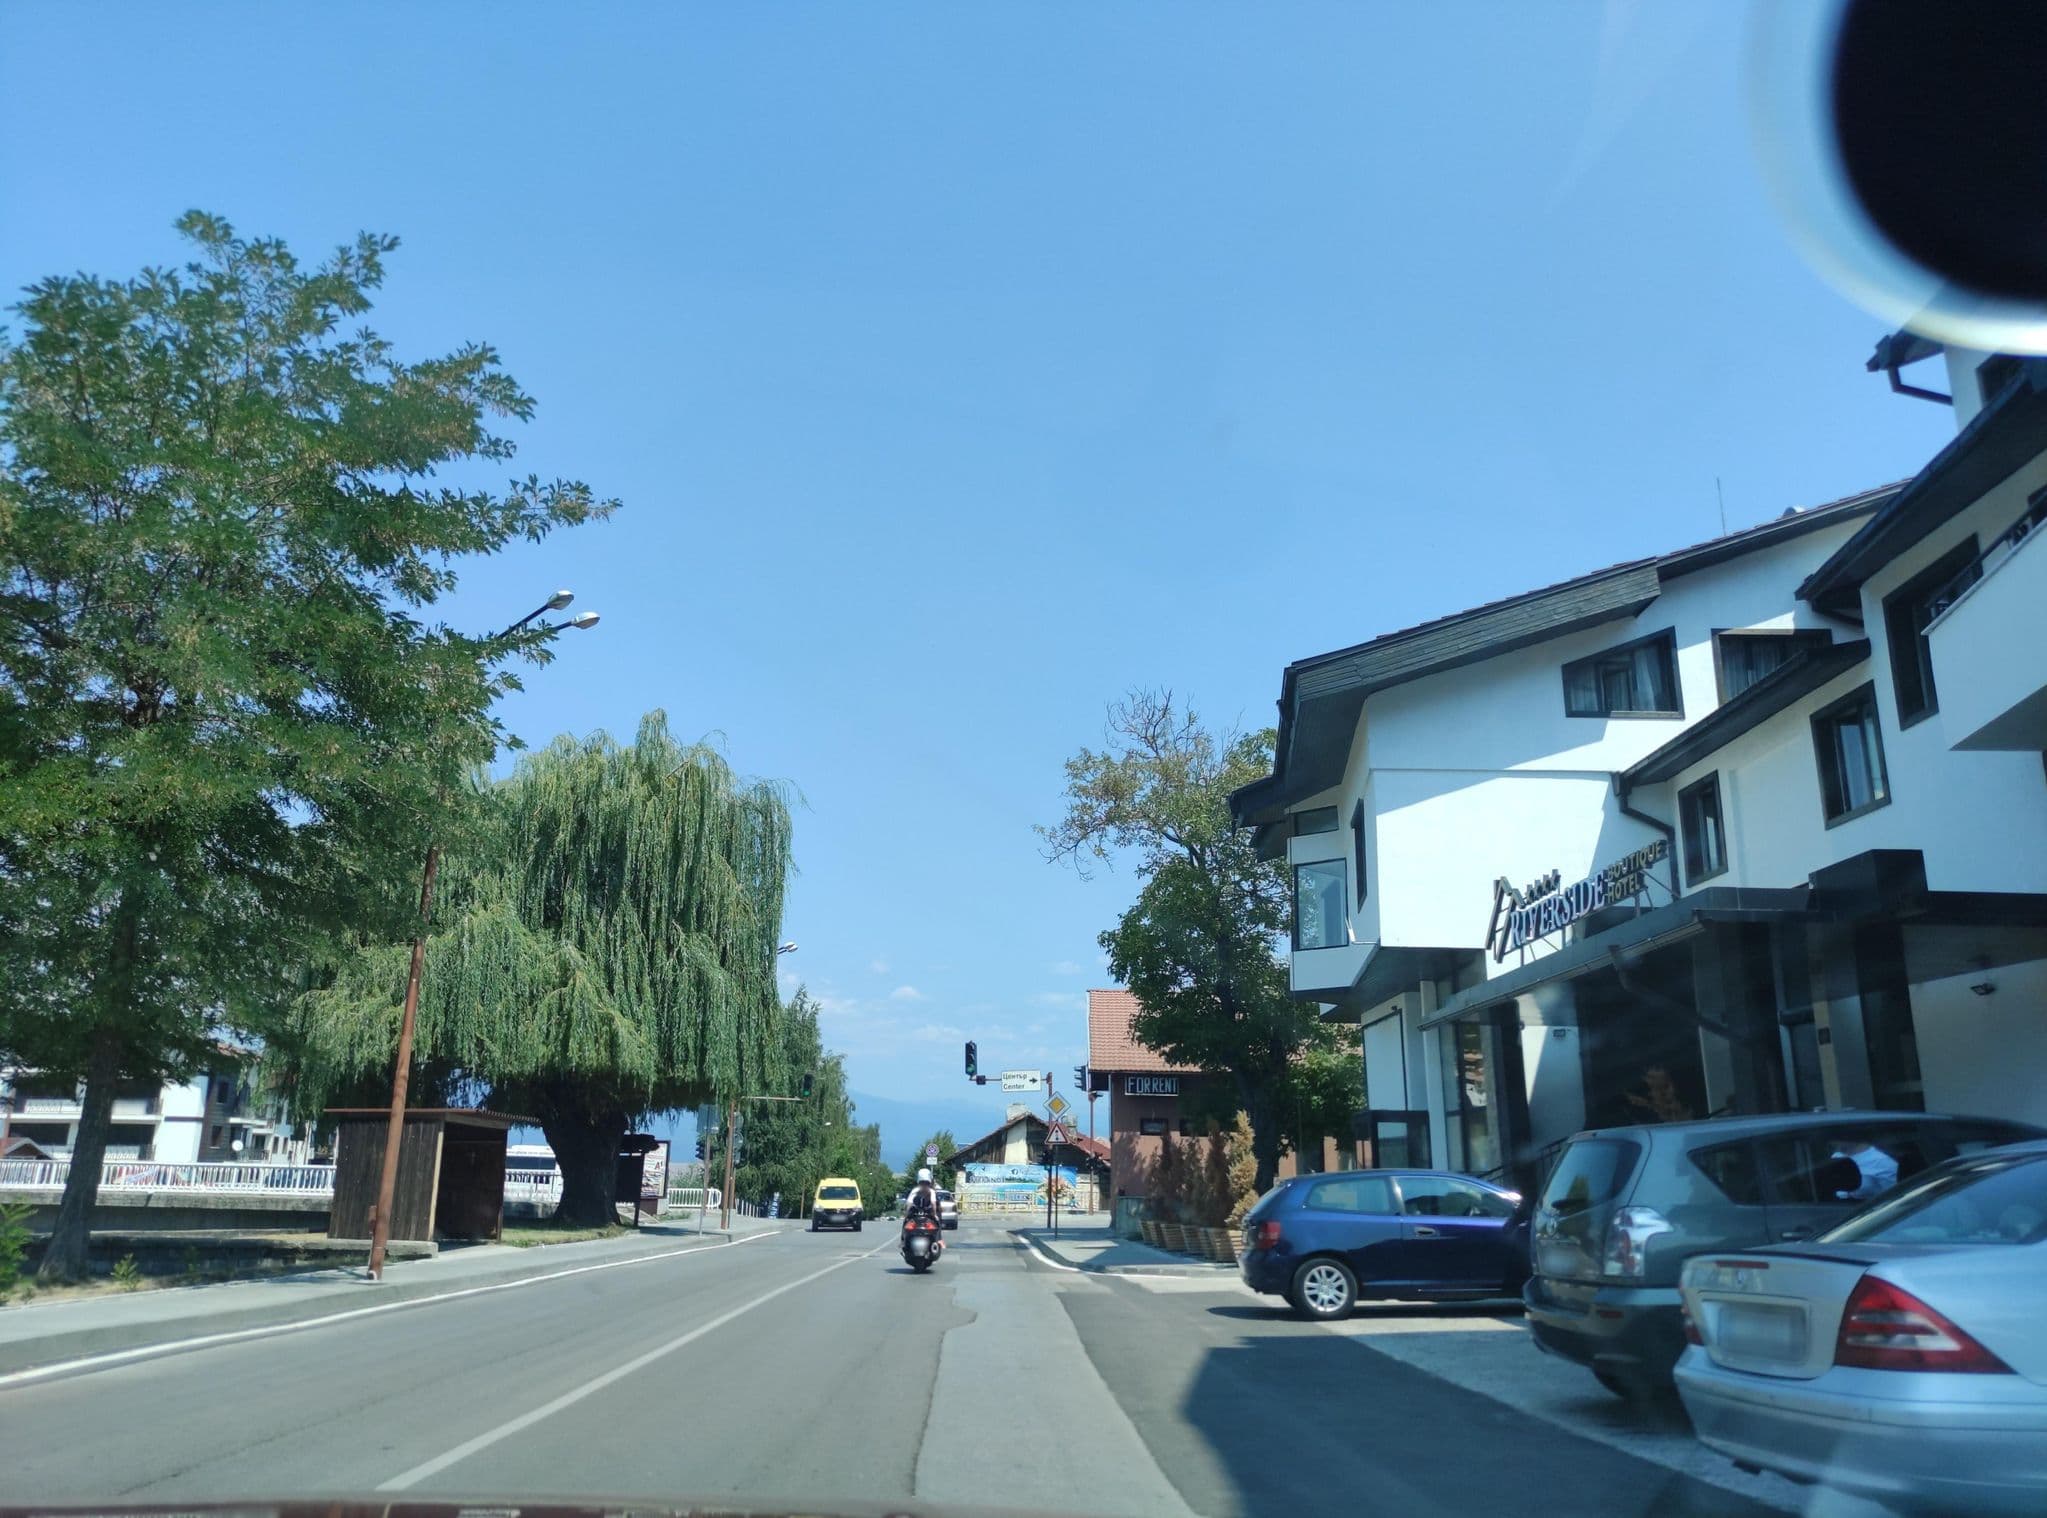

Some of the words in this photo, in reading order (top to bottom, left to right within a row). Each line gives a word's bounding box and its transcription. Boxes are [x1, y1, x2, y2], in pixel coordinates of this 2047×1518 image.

[1607, 839, 1668, 880] BOUTIQUE
[1607, 871, 1642, 903] HOTEL
[1510, 873, 1607, 949] RIVERSIDE
